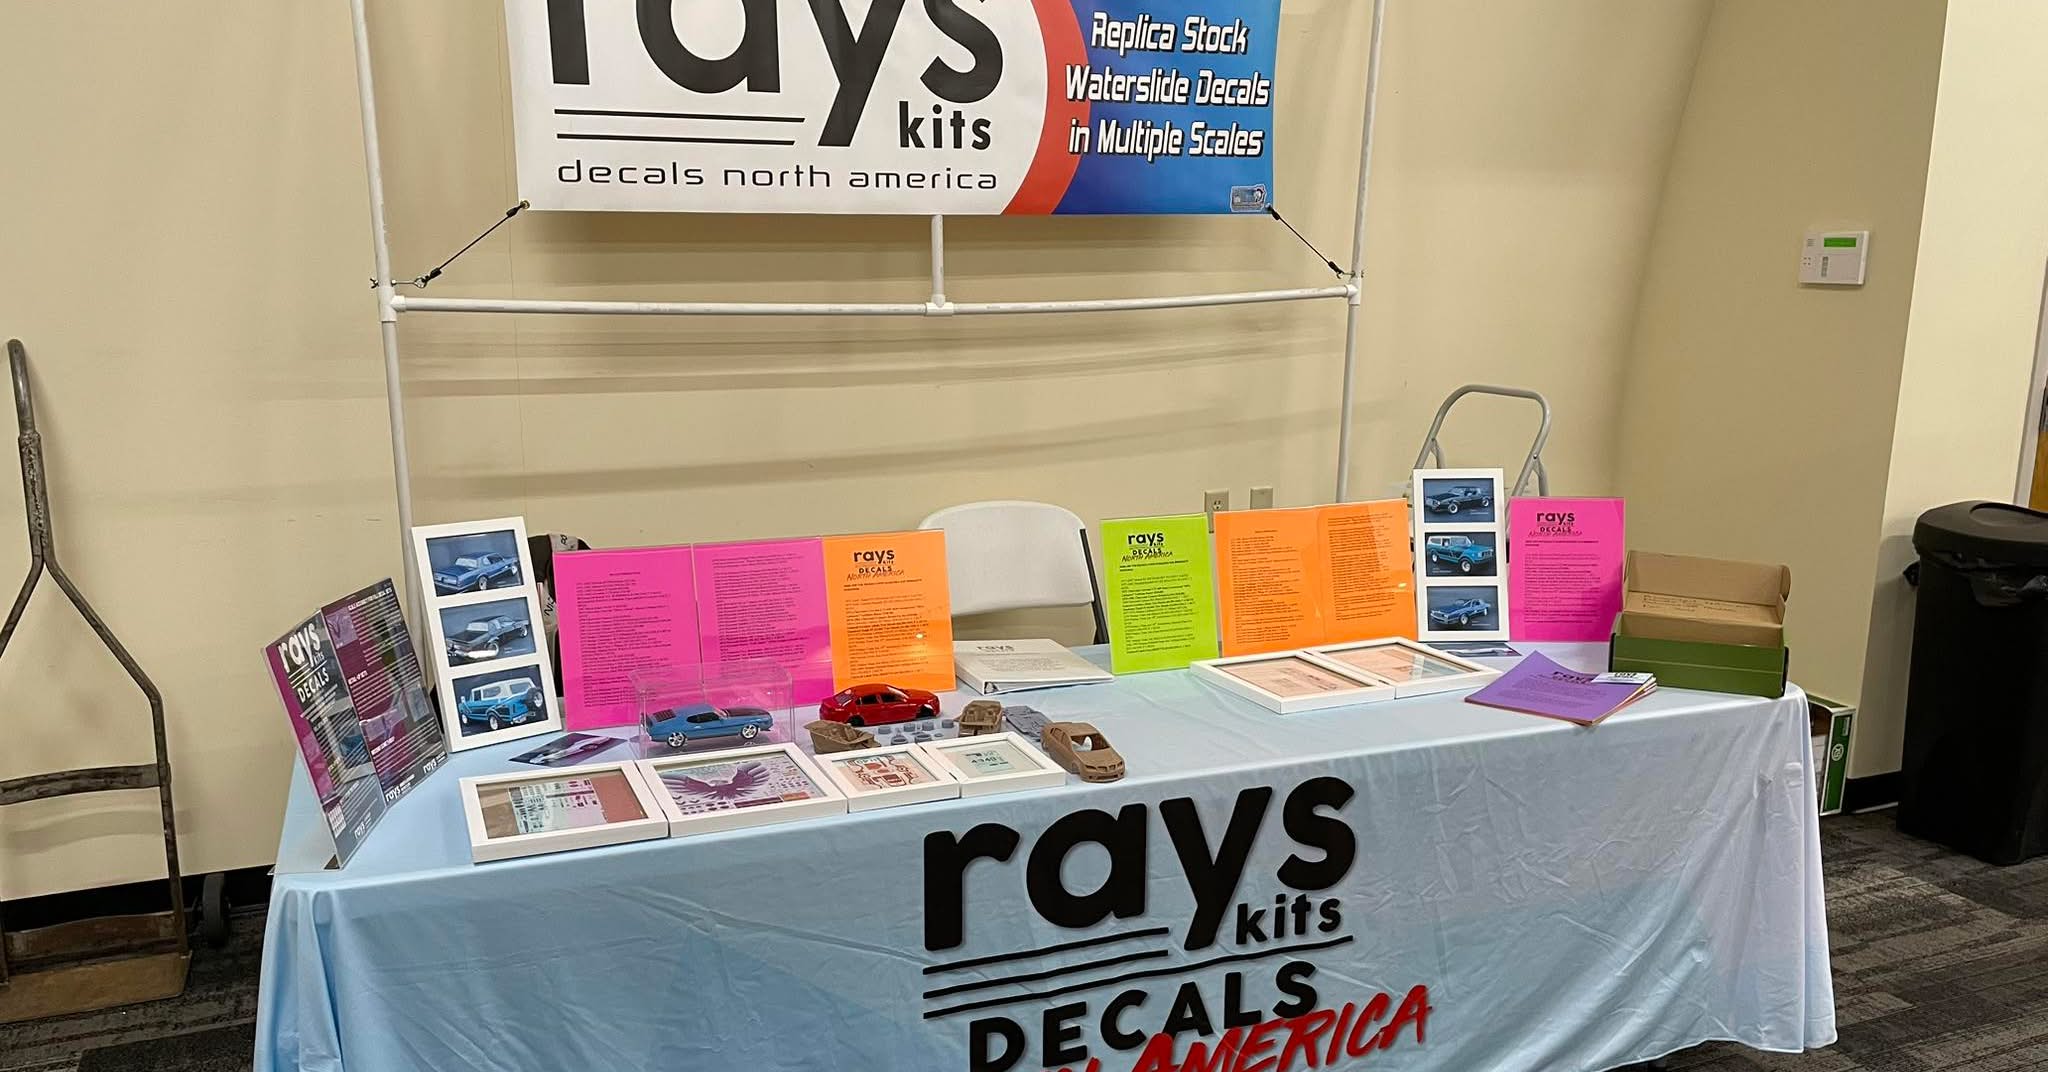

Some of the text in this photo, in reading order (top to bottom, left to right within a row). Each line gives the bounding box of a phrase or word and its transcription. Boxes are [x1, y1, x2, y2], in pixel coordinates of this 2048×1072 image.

[1091, 12, 1249, 56] Replica Stock
[1065, 64, 1270, 107] Waterslide Decals
[900, 101, 991, 150] kits
[1068, 118, 1264, 163] in Multiple Scales
[557, 159, 997, 190] decals north america
[1127, 532, 1164, 547] rays
[1536, 512, 1575, 525] rays
[853, 549, 895, 564] rays
[858, 565, 892, 574] DECALS
[1132, 547, 1161, 556] DECALS
[278, 623, 321, 673] rays
[297, 667, 330, 703] DECALS
[924, 776, 1356, 951] rays
[1236, 894, 1342, 945] kits
[969, 960, 1319, 1072] DECALS
[1131, 985, 1432, 1072] AMERICA
